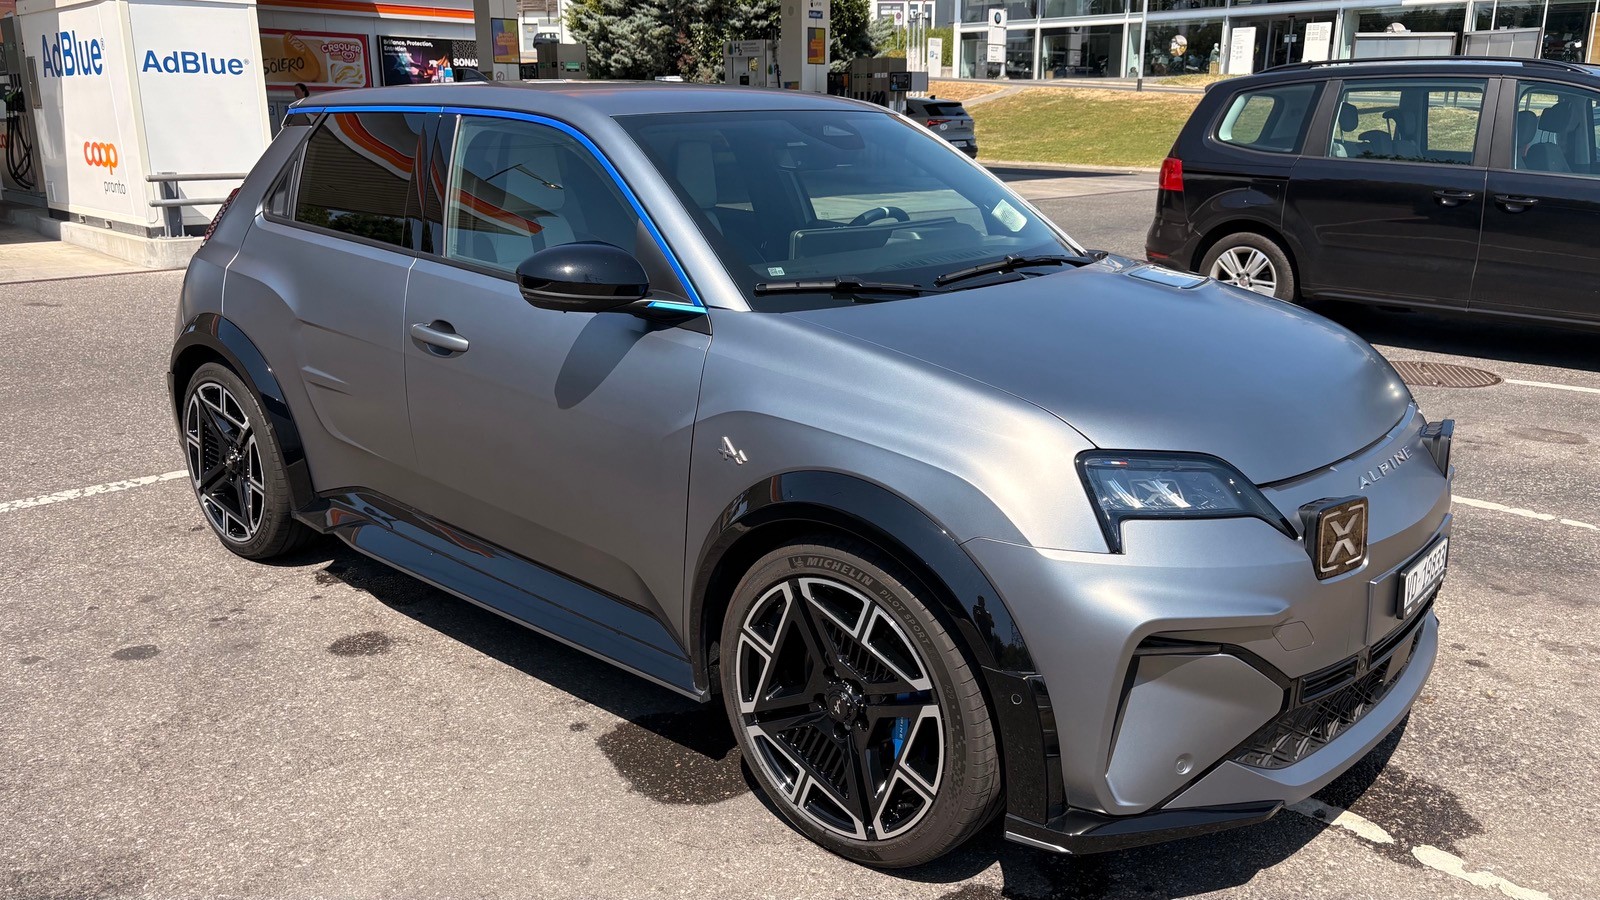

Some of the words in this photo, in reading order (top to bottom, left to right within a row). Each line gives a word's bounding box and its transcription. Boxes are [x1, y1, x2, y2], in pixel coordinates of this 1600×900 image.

[406, 40, 433, 48] Protection,
[83, 141, 118, 175] coop
[103, 180, 127, 195] pronto
[1358, 445, 1412, 490] ALPINE
[806, 556, 873, 587] MICHELIN
[879, 589, 905, 613] PILOT
[903, 612, 931, 646] SPORT
